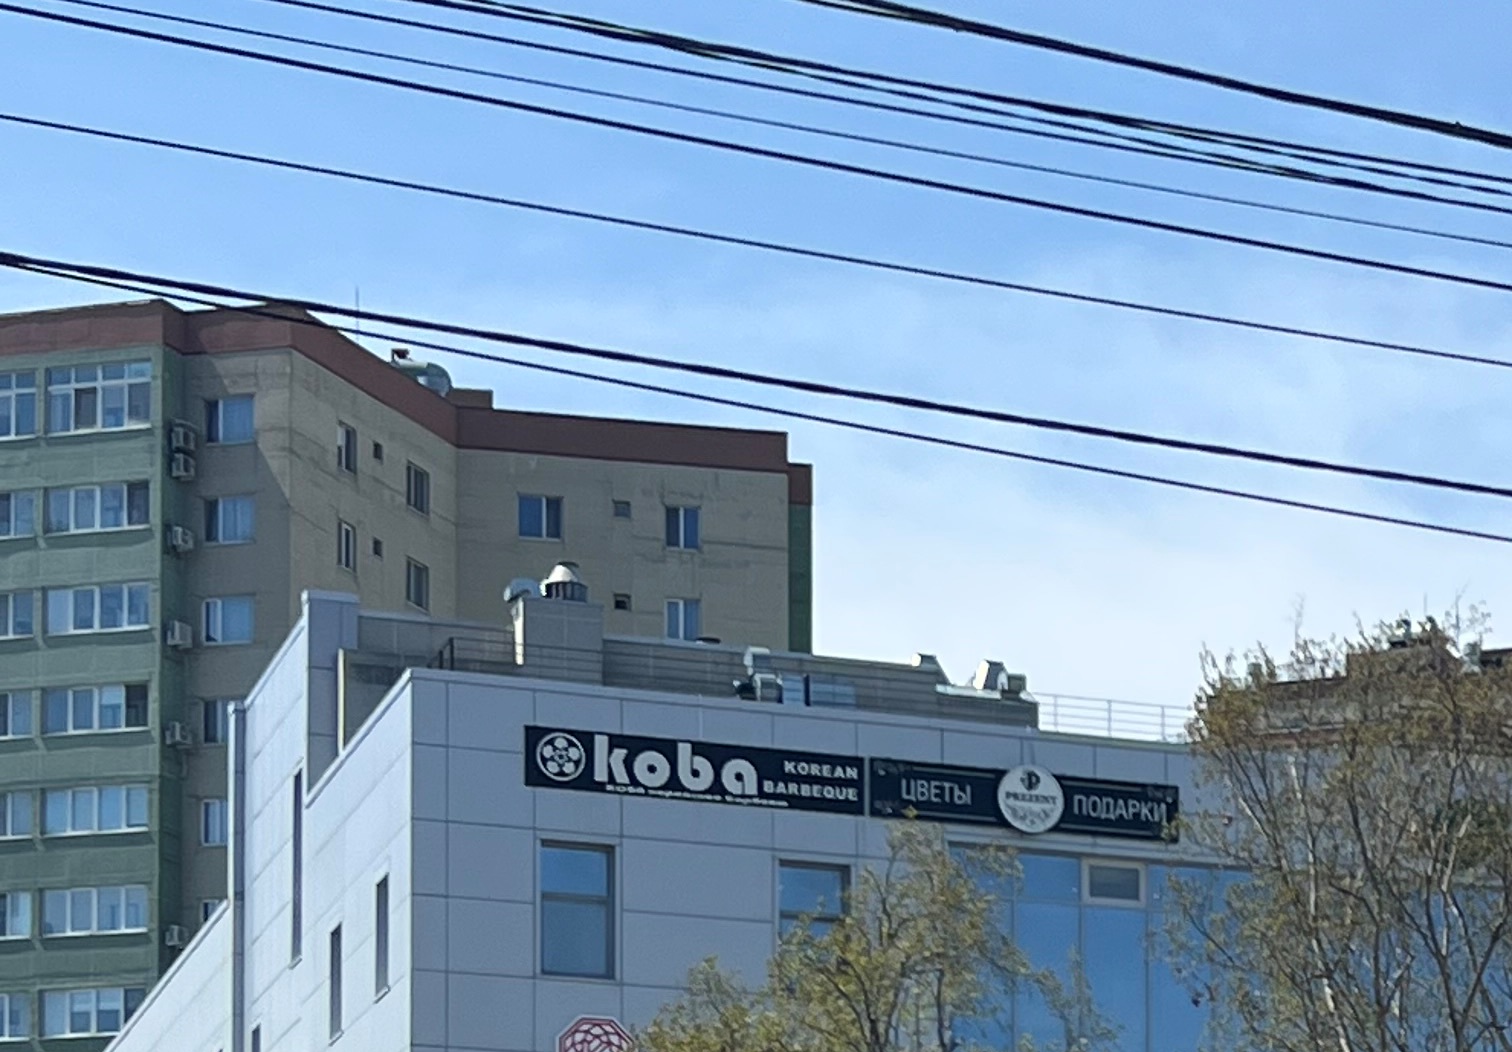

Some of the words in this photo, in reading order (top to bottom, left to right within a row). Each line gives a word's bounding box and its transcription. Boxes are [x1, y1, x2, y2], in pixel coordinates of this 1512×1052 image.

[594, 734, 758, 796] koba
[783, 759, 859, 780] KOREAN
[763, 779, 859, 802] BARBEQUE
[901, 778, 971, 806] ЦВЕТЫ
[1073, 795, 1168, 823] ПОДАРКИ
